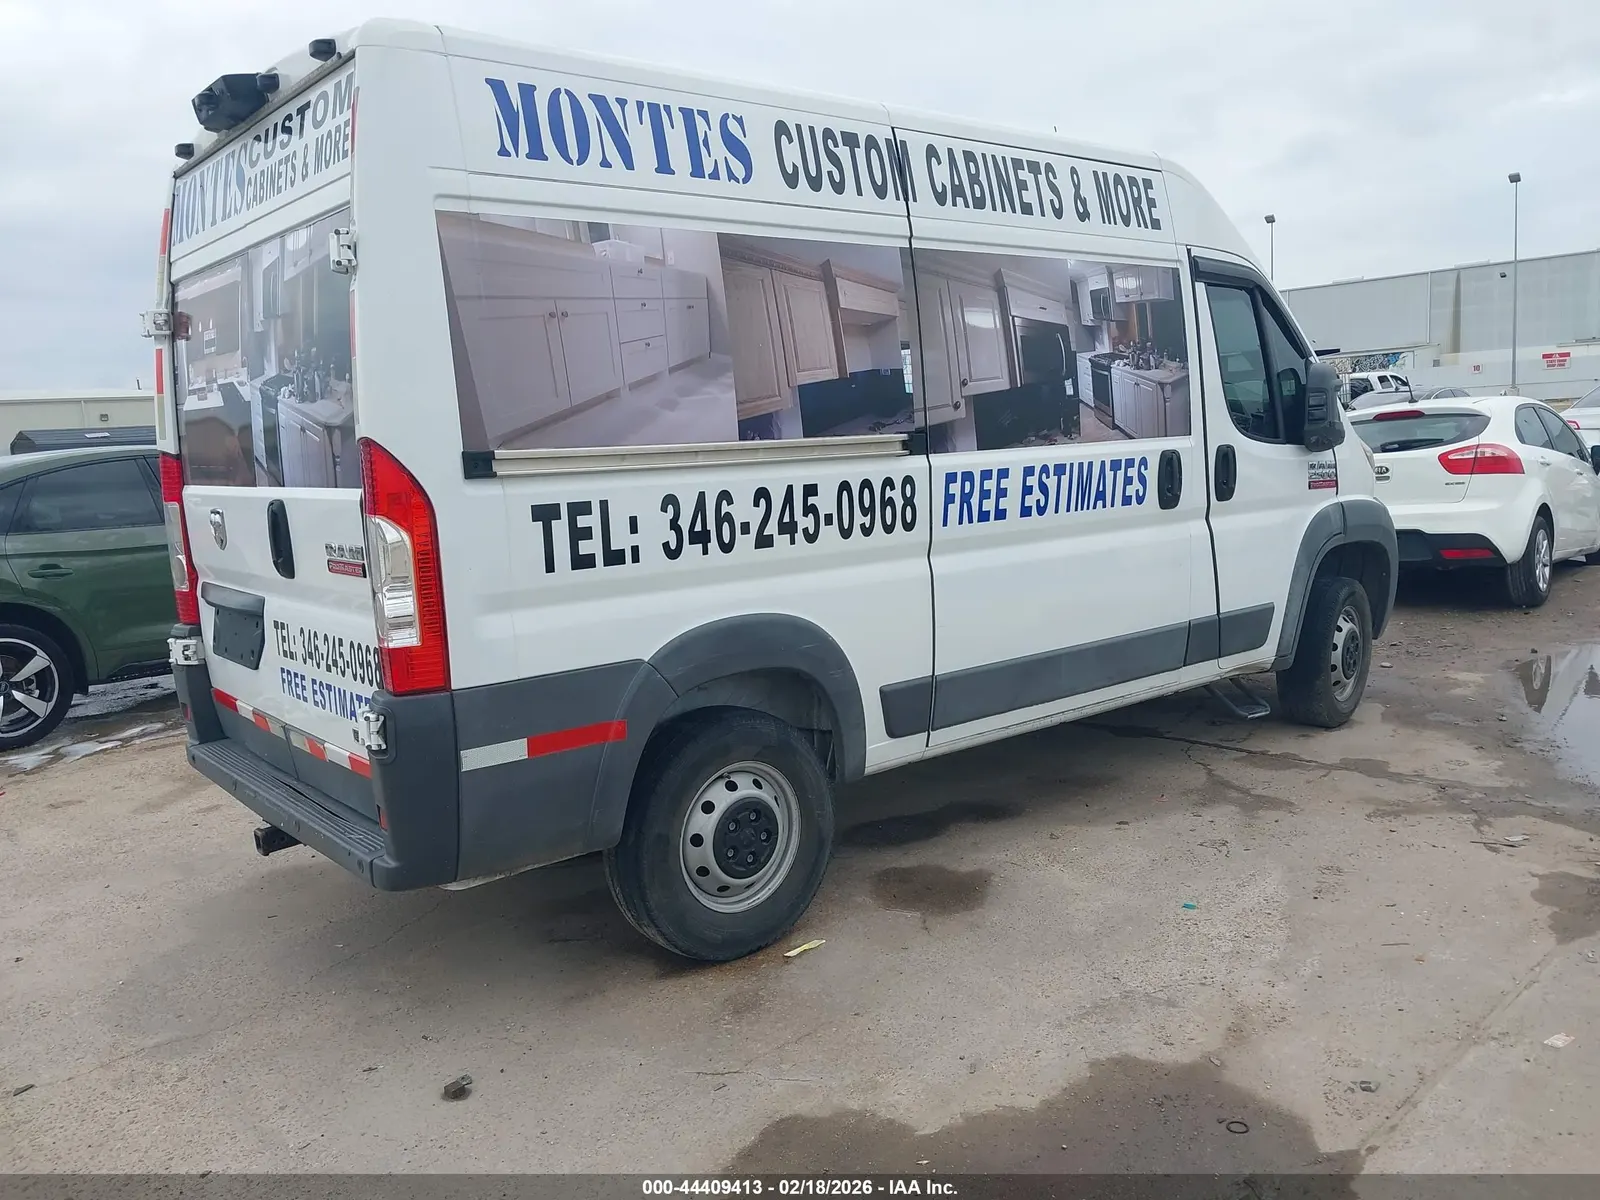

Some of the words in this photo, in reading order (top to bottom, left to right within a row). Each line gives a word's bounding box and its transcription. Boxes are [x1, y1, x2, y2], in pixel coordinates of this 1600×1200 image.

[246, 149, 298, 211] CABINETS
[302, 143, 309, 182] &
[314, 118, 351, 175] MORE
[248, 71, 354, 168] CUSTOM
[485, 78, 753, 185] MONTES
[774, 119, 918, 202] CUSTOM
[925, 143, 1064, 220] CABINETS
[1070, 165, 1091, 223] &
[1092, 169, 1162, 231] MORE
[172, 140, 248, 247] MONTES
[530, 499, 640, 574] TEL:
[660, 475, 917, 561] 346-245-0968
[942, 467, 1010, 527] FREE
[1019, 456, 1148, 518] ESTIMATES
[273, 619, 298, 662] TEL:
[300, 626, 385, 690] 346-245-0968
[280, 667, 308, 704] FREE
